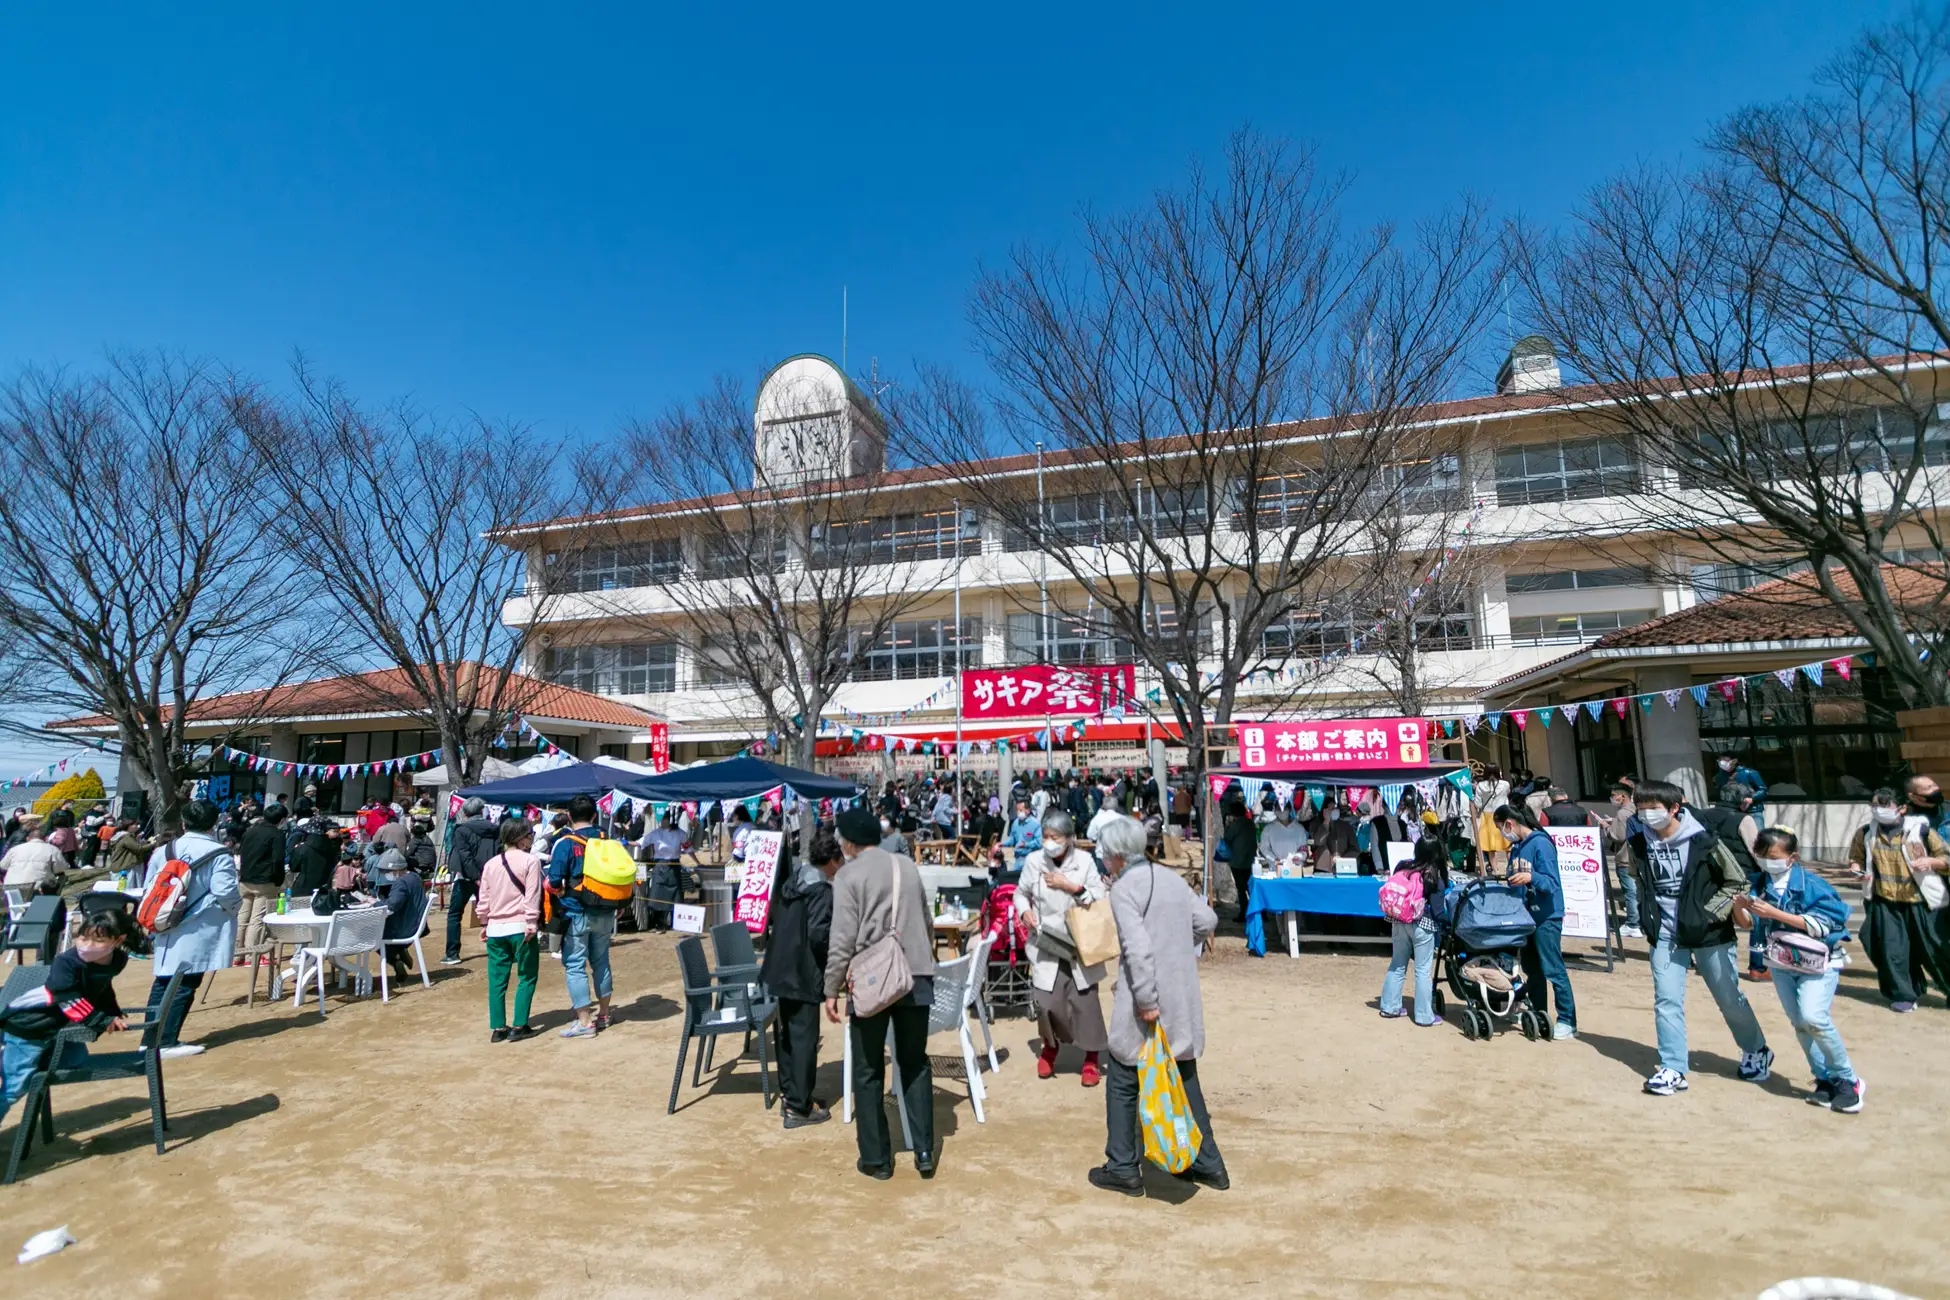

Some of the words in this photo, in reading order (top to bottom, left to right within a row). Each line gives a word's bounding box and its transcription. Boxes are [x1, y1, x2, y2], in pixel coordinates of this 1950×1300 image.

[746, 859, 775, 878] 玉ねぎ
[743, 878, 766, 892] スープ
[738, 898, 768, 923] 無料
